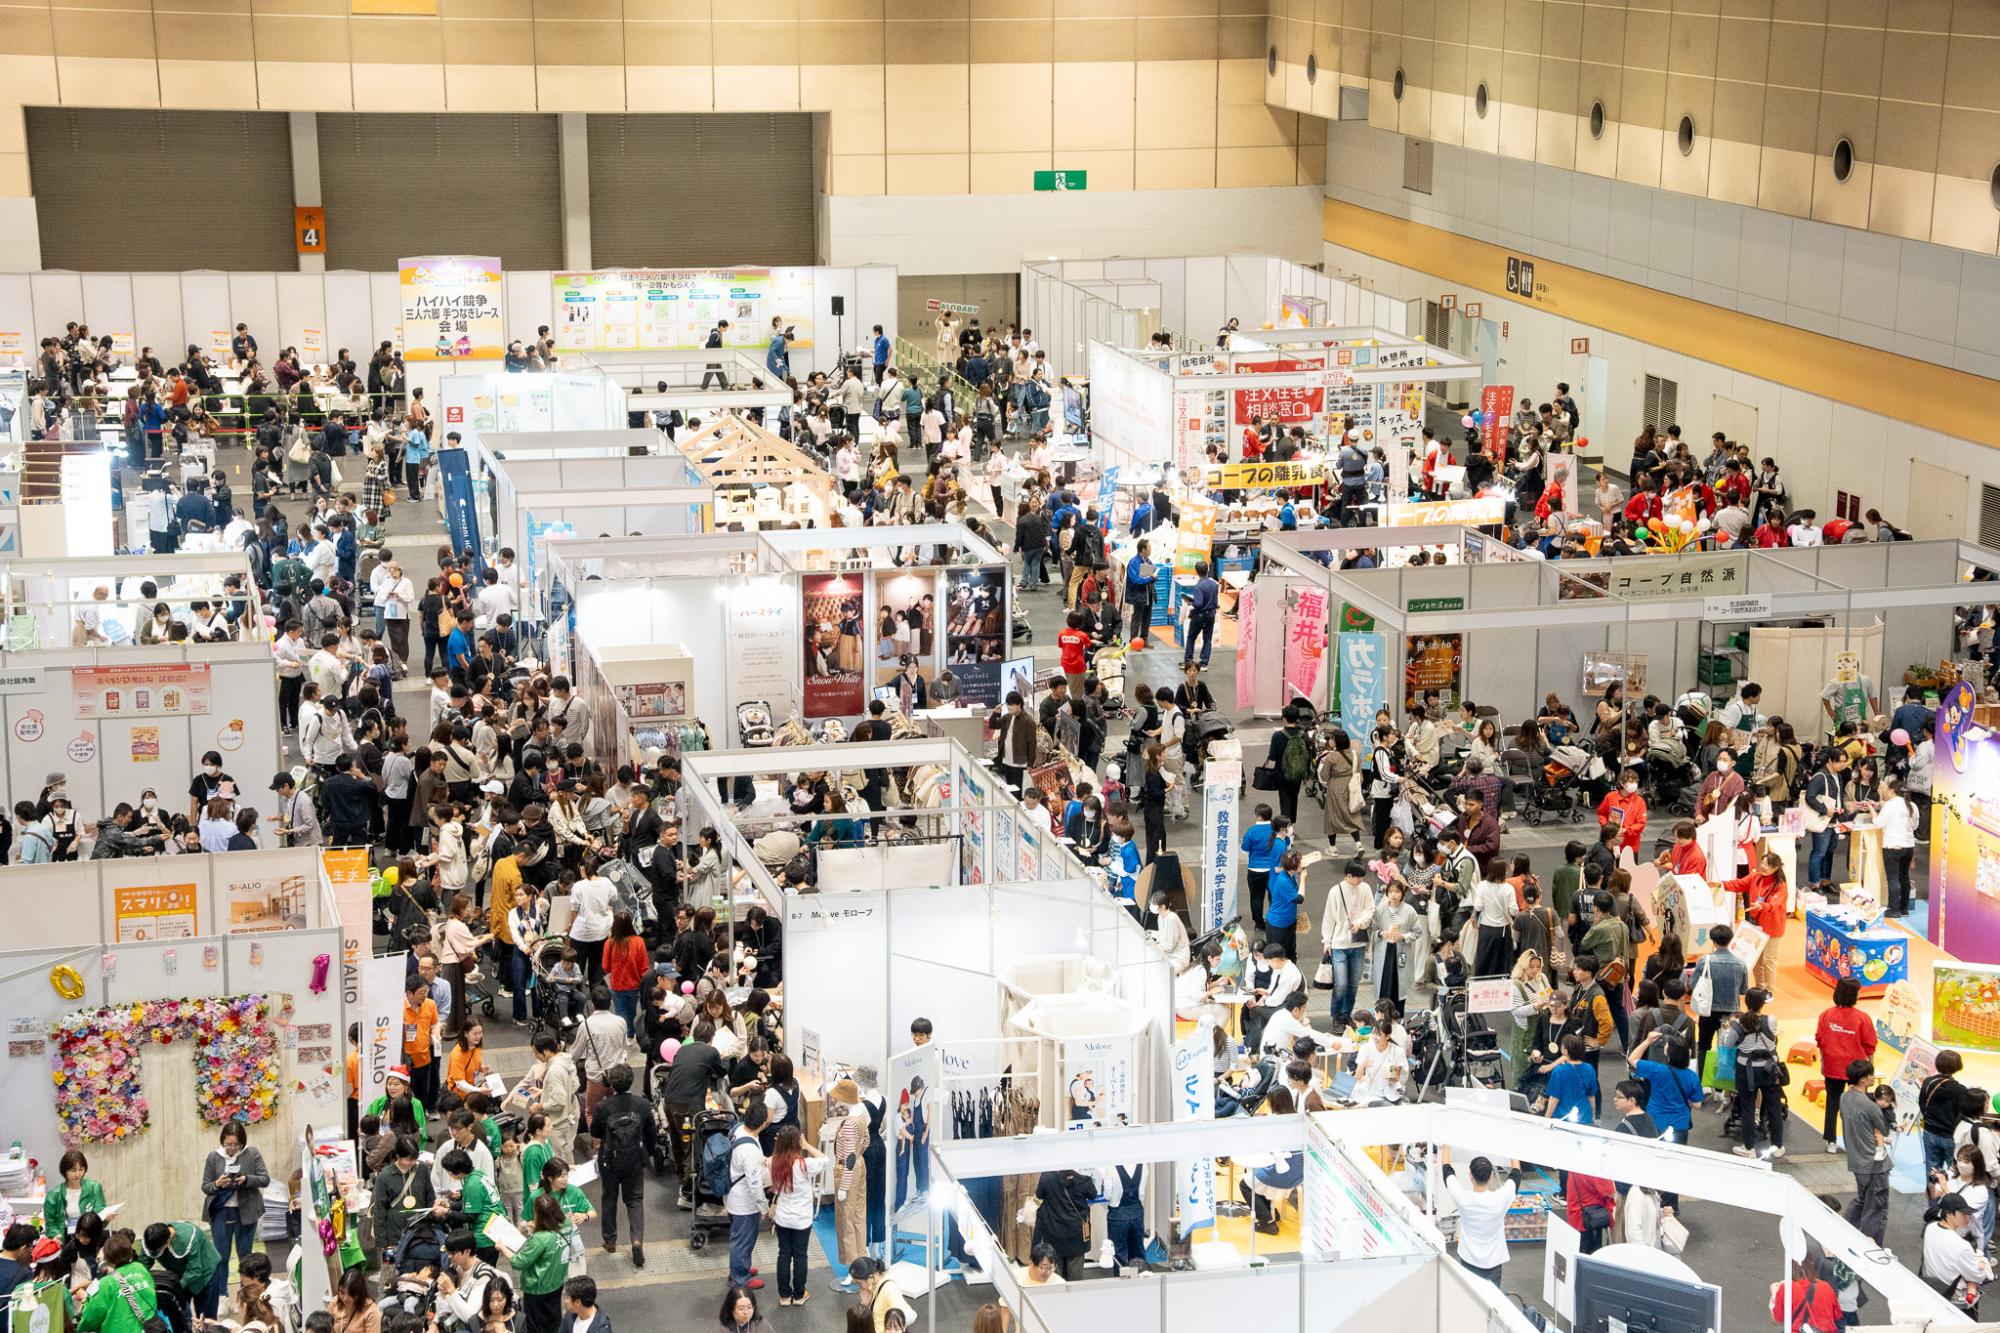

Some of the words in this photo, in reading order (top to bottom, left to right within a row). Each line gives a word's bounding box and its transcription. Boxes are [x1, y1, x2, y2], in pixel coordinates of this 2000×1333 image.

[305, 228, 318, 246] 4
[416, 294, 488, 307] ハイハイ競争
[405, 309, 440, 320] 三人六脚
[443, 308, 499, 320] 手つなぎレース
[439, 321, 468, 332] 会場
[1182, 355, 1215, 368] 住宅会社
[1246, 401, 1307, 419] 相談窓口
[1379, 413, 1404, 425] キッズ
[1391, 420, 1424, 436] スペース
[1207, 463, 1324, 486] コープの離乳食
[1618, 567, 1736, 588] コープ自然派
[1291, 591, 1324, 644] 福井
[1406, 655, 1460, 667] オーガニック
[807, 675, 833, 686] Snow
[833, 672, 862, 684] White
